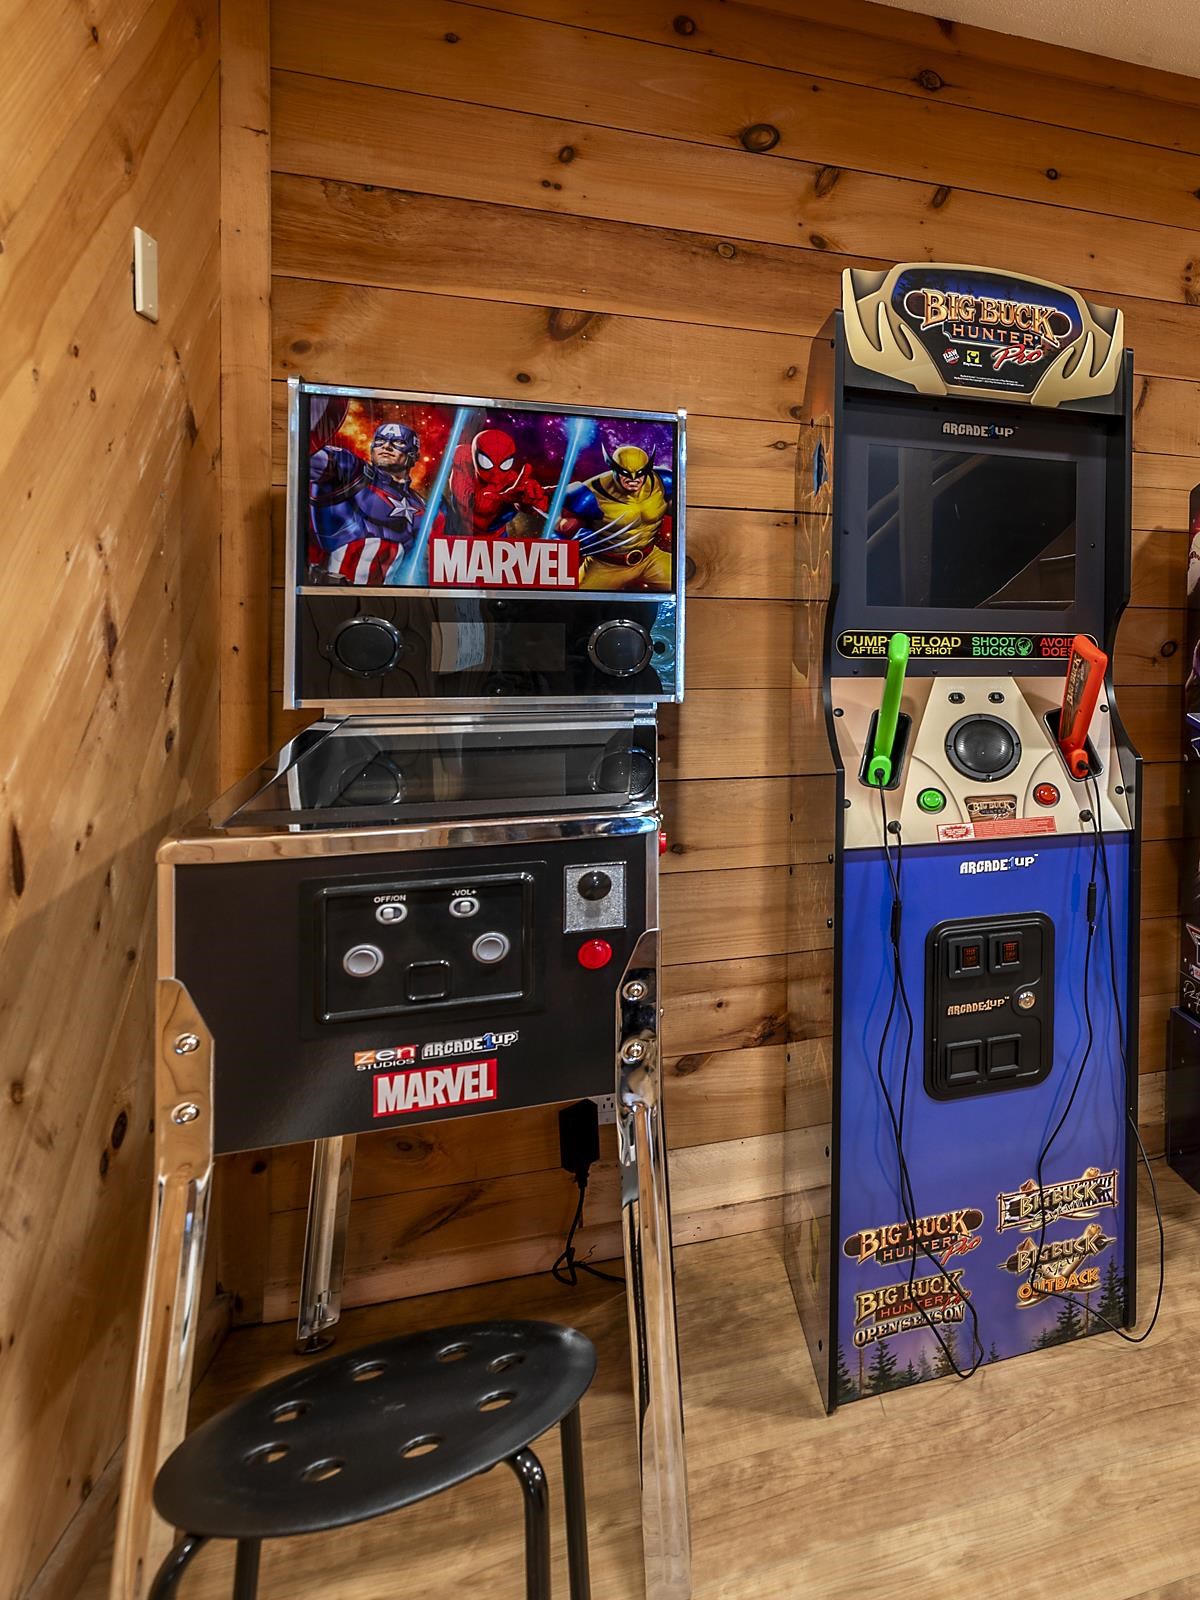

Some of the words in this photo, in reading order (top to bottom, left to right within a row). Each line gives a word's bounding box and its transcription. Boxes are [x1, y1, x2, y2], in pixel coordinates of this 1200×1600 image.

[922, 289, 976, 330] BIG
[979, 297, 1060, 347] BUCK
[952, 323, 1034, 346] HUNTER
[991, 343, 1044, 370] Pro
[433, 538, 575, 585] MARVEL
[852, 647, 886, 655] AFTER
[925, 647, 953, 655] SHOT
[971, 636, 1016, 646] SHOOT
[972, 647, 1016, 657] BUCKS
[374, 895, 407, 904] OFF/ON
[423, 1032, 518, 1058] ARCADE1UP
[356, 1058, 415, 1072] STUDIOS
[377, 1063, 494, 1114] MARVEL
[1052, 1182, 1099, 1203] BUCK
[857, 1223, 903, 1264] BIG
[906, 1208, 971, 1241] BUCK
[1051, 1234, 1099, 1258] BUCK
[1017, 1267, 1100, 1300] OUTBACK
[857, 1287, 899, 1324] BIG
[903, 1270, 964, 1301] BUCK
[852, 1320, 900, 1346] OPEN
